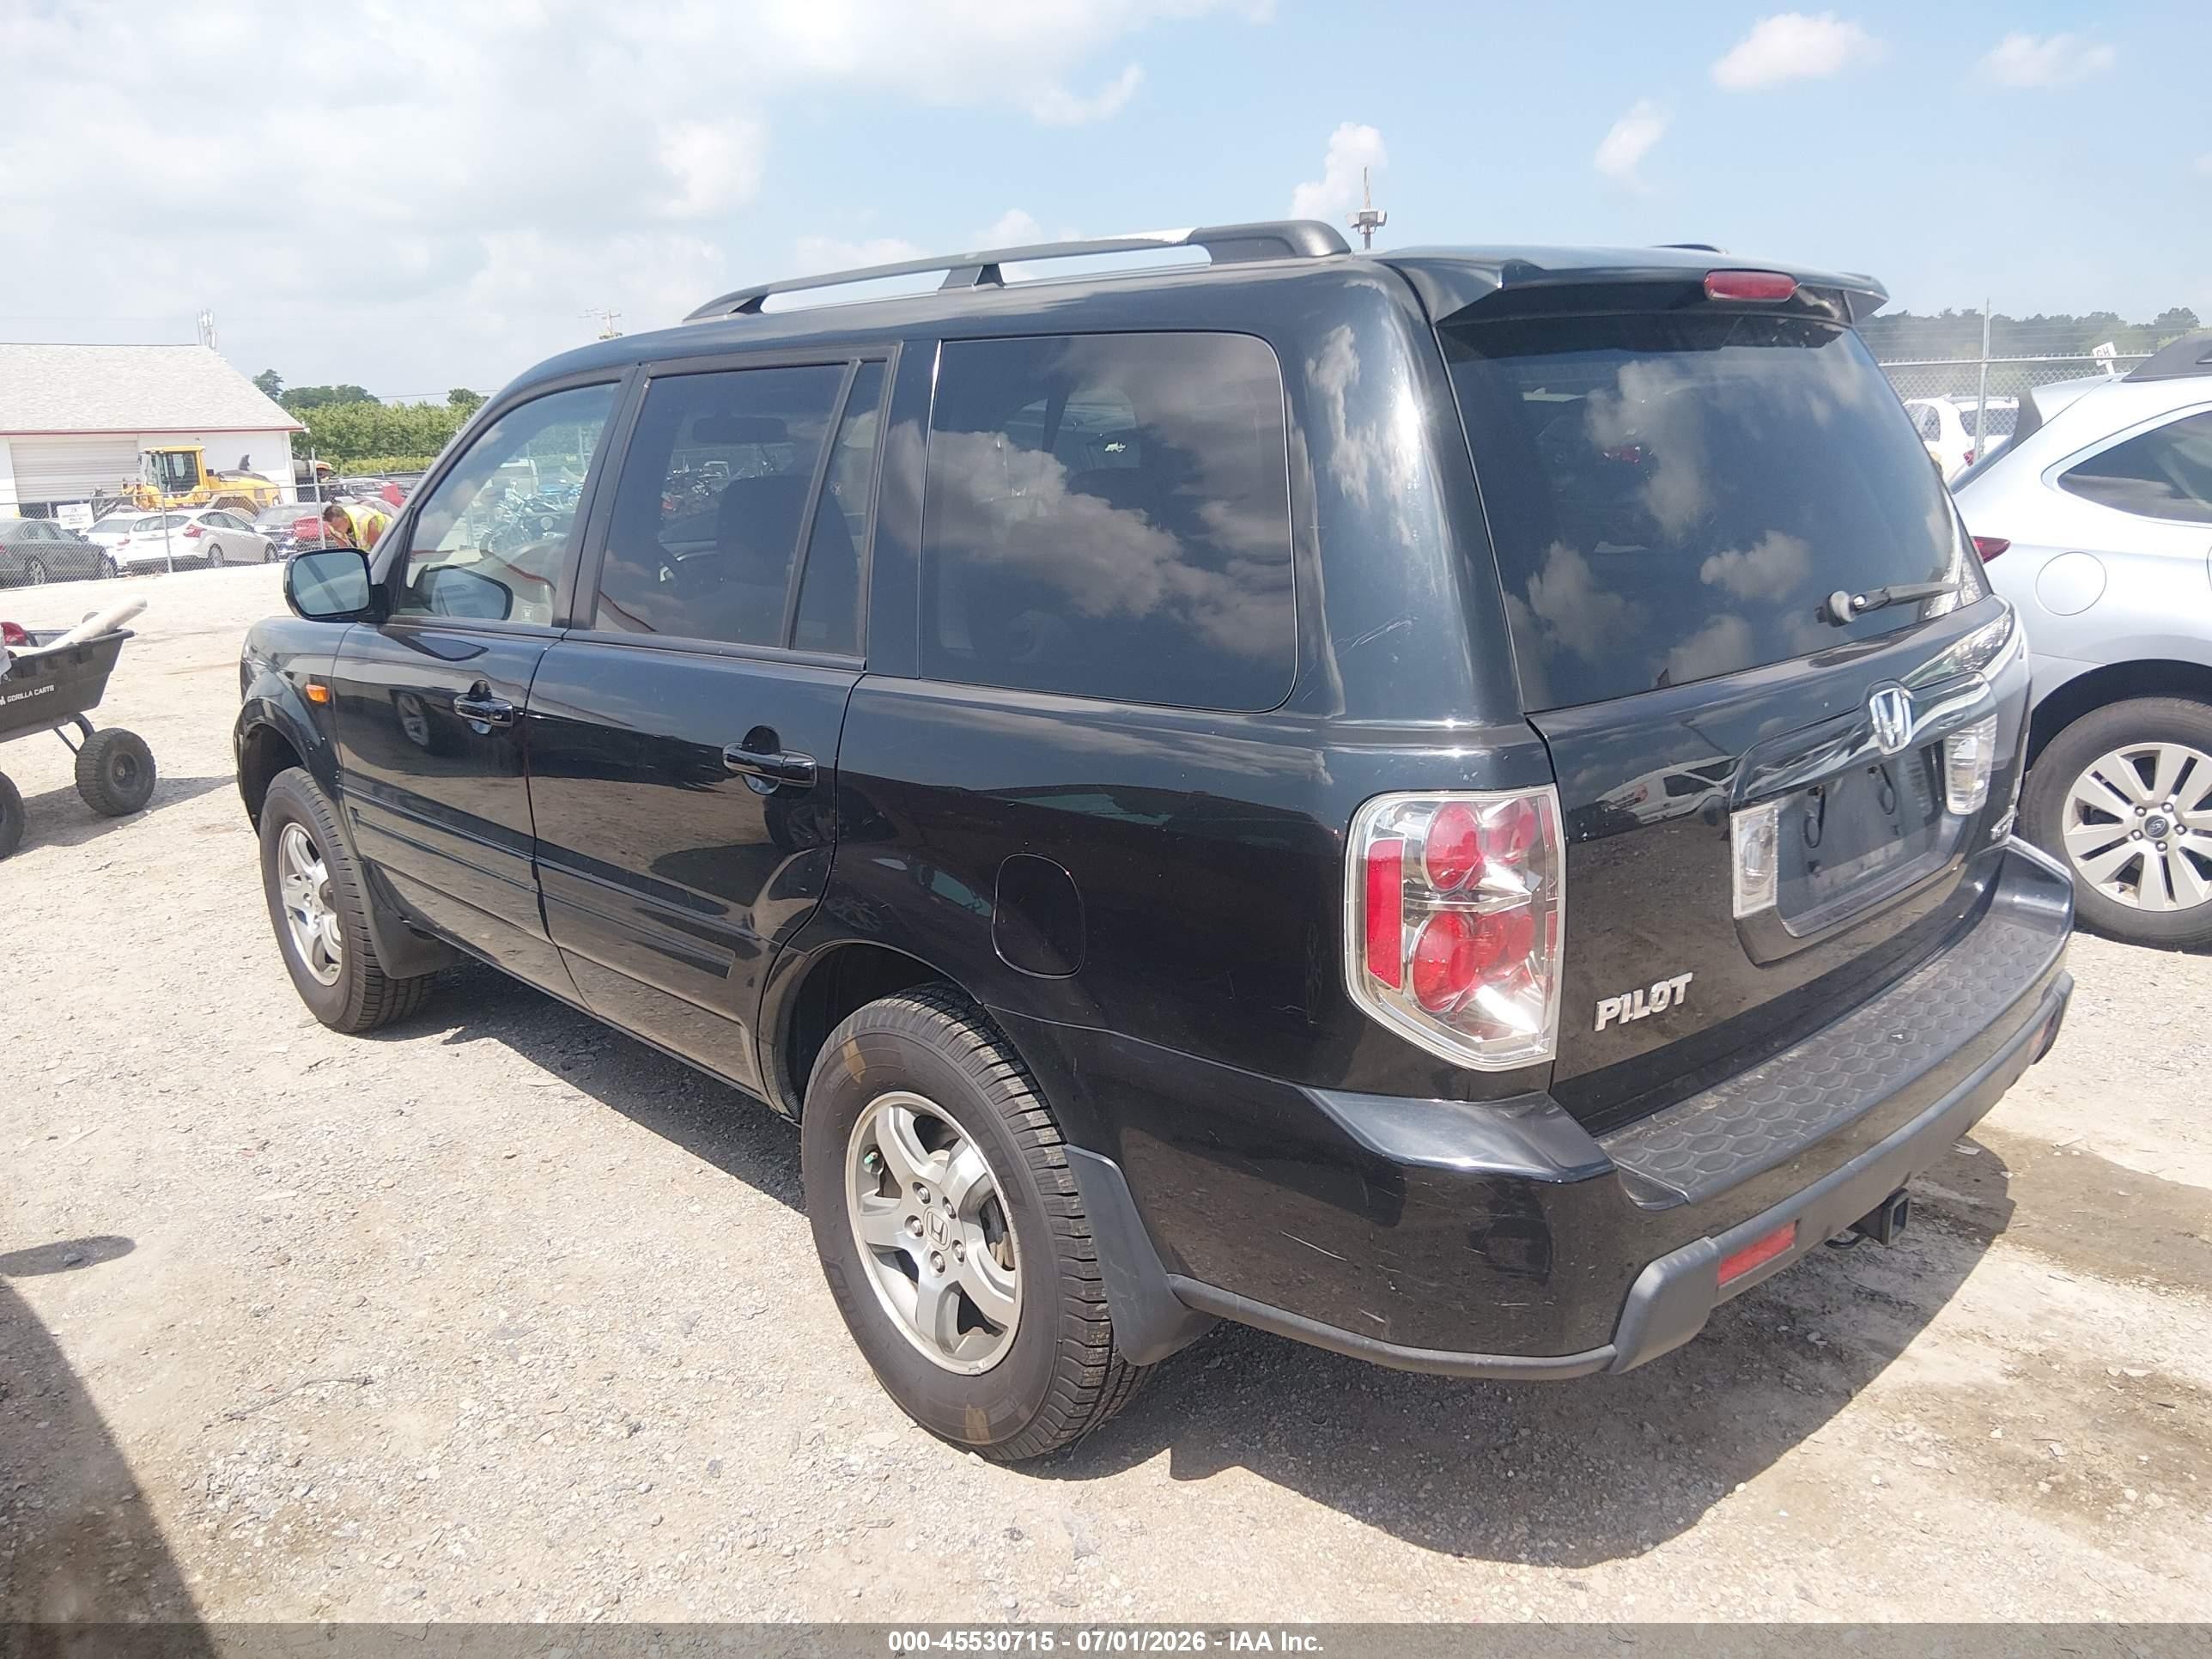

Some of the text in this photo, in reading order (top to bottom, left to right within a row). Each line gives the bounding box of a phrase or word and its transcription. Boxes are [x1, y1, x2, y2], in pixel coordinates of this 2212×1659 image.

[7, 684, 55, 702] GORILLA CARTS
[1595, 971, 1693, 1032] PILOT
